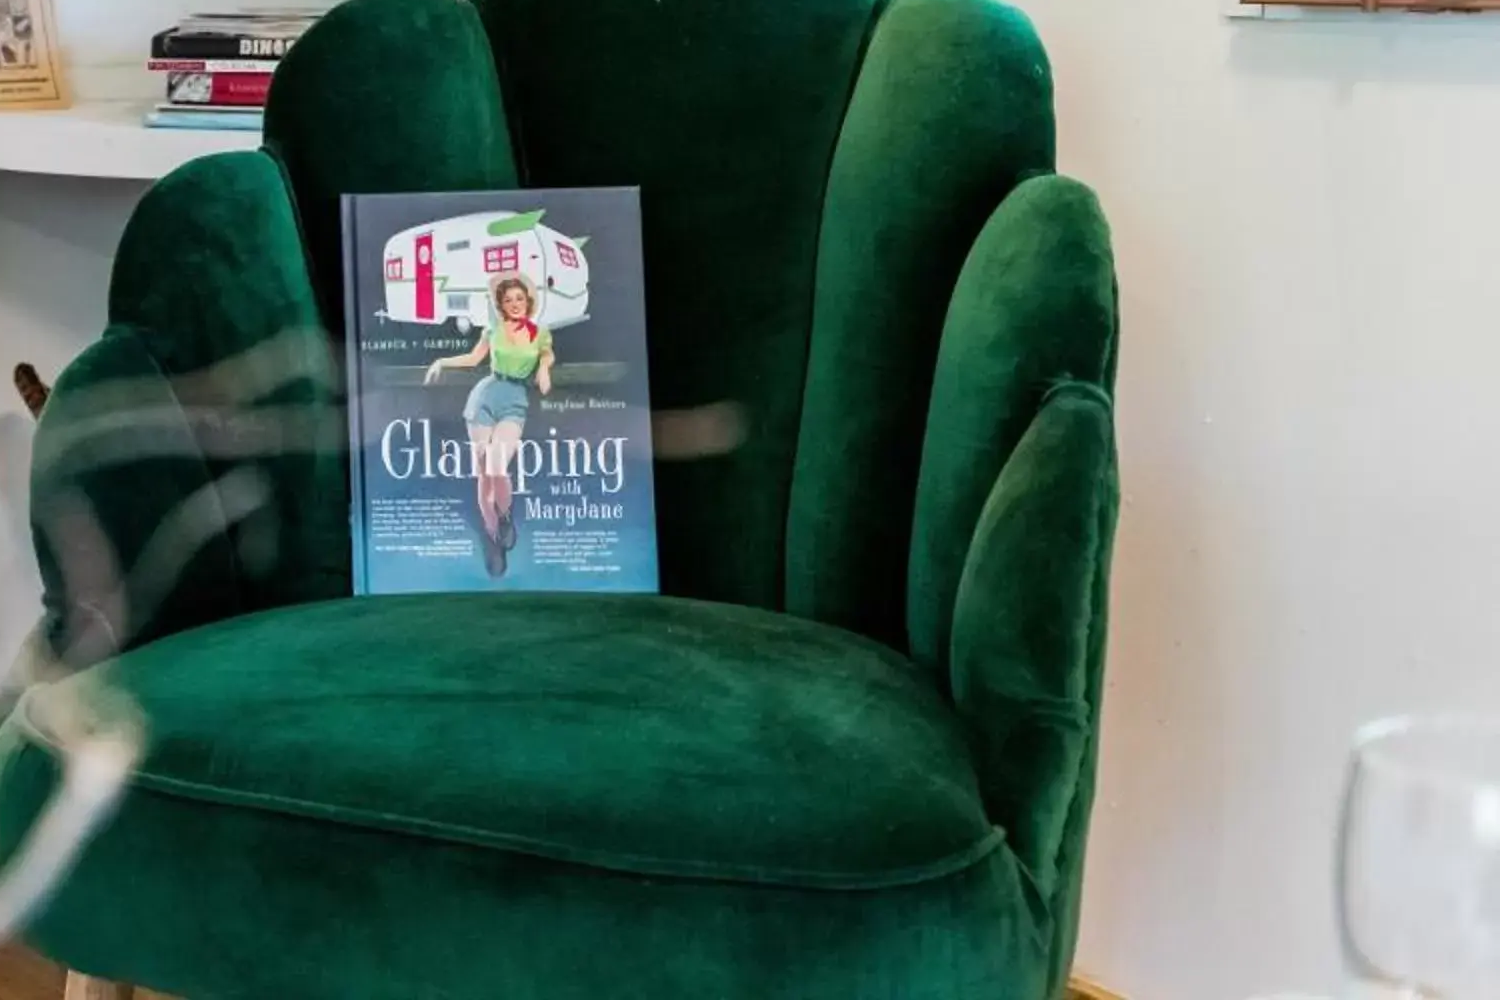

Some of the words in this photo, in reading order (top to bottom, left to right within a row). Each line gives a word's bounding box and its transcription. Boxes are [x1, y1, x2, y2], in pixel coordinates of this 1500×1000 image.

[381, 418, 628, 493] Glamping
[550, 479, 582, 496] with
[525, 495, 624, 527] MaryJane
